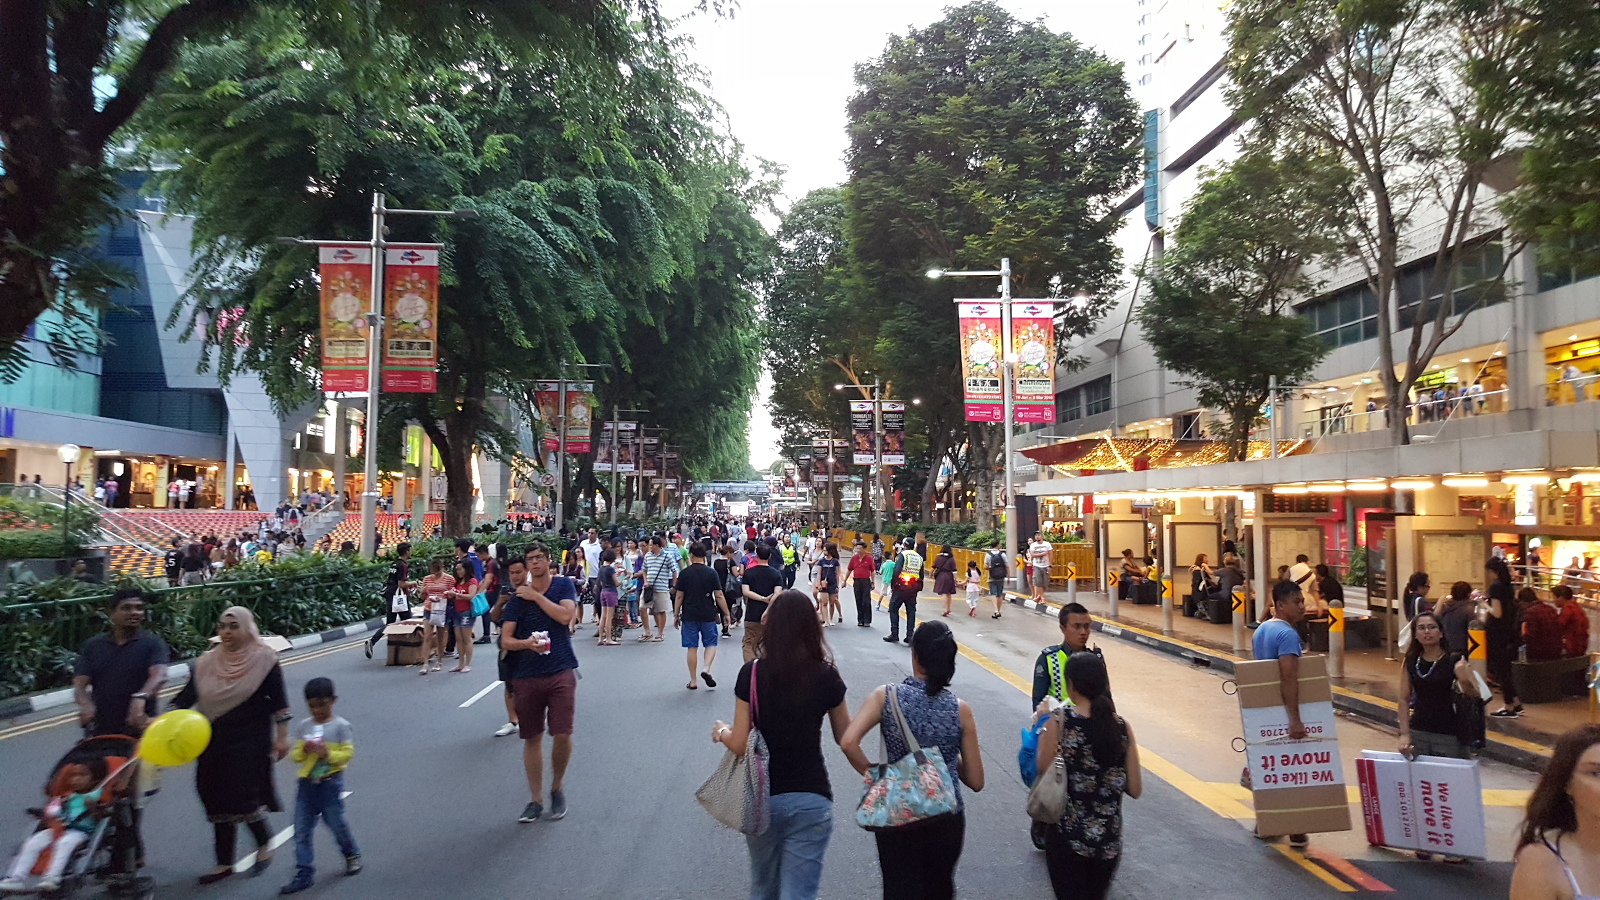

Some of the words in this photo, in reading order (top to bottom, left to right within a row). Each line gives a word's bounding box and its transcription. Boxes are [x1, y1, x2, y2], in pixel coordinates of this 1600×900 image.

[1260, 725, 1323, 737] 80012708
[1261, 755, 1276, 771] it
[1280, 751, 1331, 766] move
[1263, 774, 1278, 785] to
[1282, 771, 1308, 785] like
[1312, 770, 1334, 782] We
[1437, 782, 1449, 802] We
[1420, 780, 1436, 827] move
[1440, 805, 1453, 830] like
[1427, 831, 1442, 845] it
[1444, 833, 1454, 846] to
